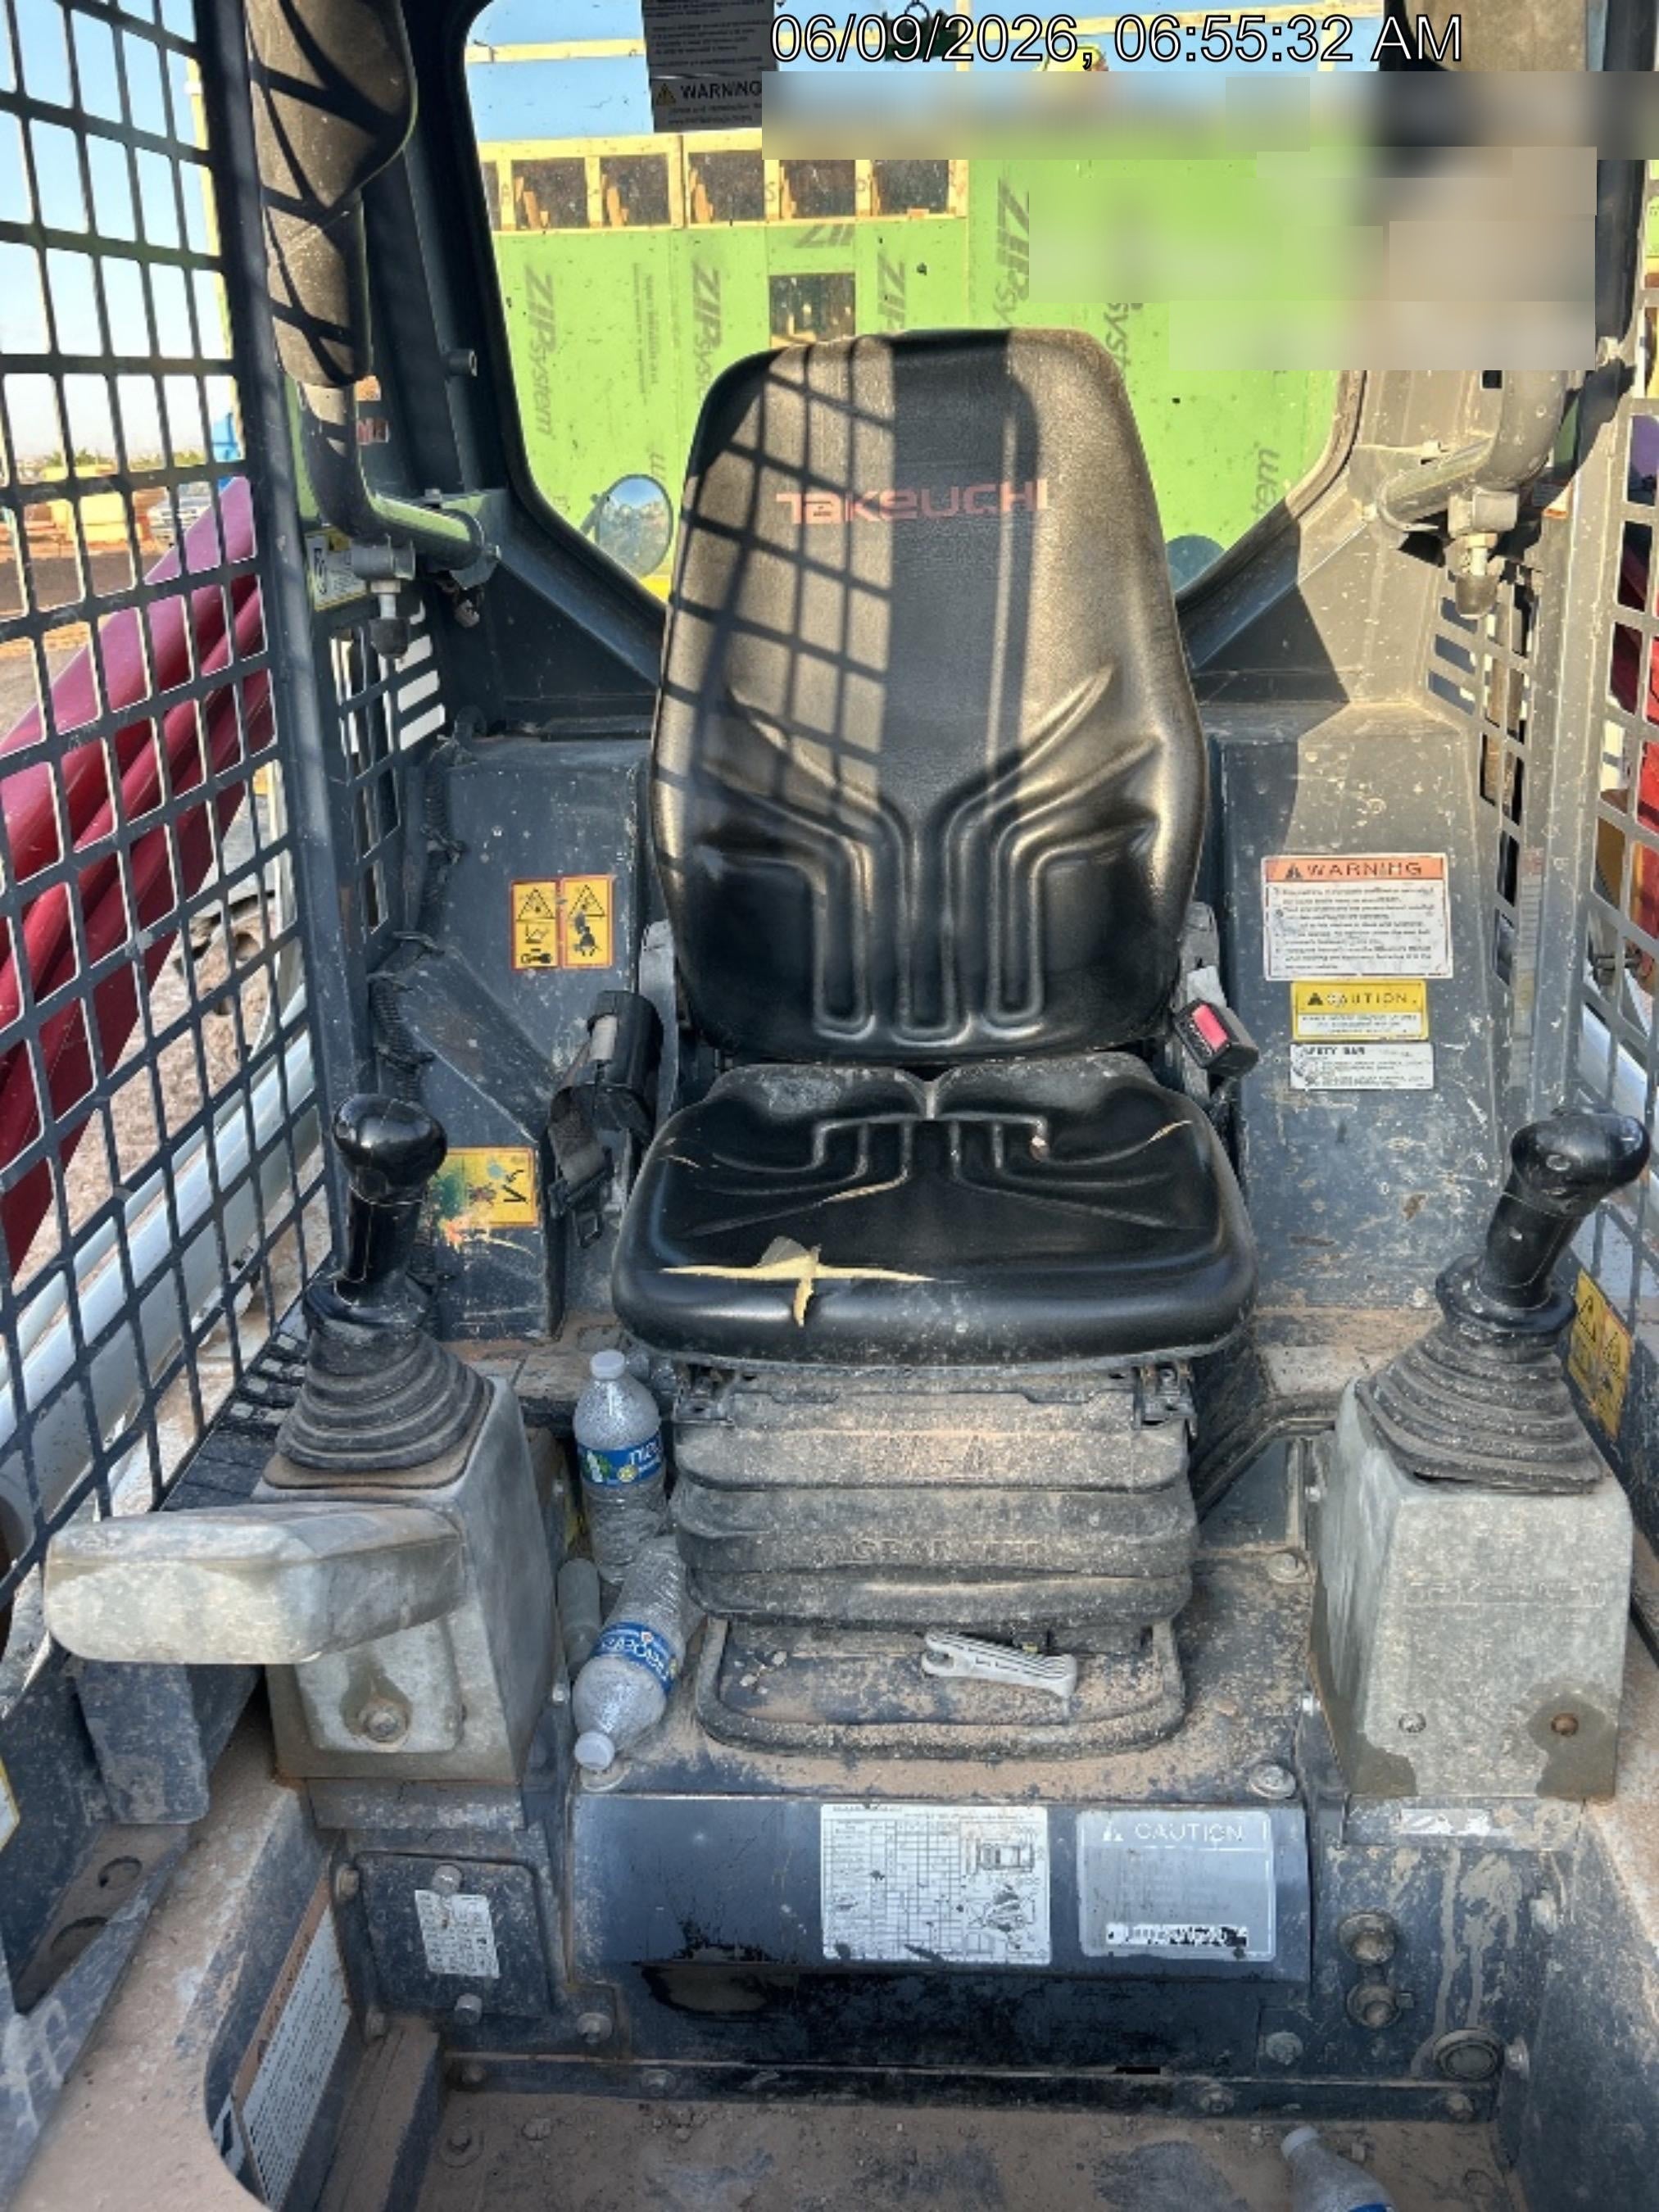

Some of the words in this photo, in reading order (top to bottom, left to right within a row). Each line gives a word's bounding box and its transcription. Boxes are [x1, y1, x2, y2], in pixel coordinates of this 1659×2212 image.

[776, 478, 1048, 524] TAKEUCHI
[1308, 862, 1422, 877] WARNING
[1326, 992, 1408, 1004] CAUTION
[1135, 1823, 1244, 1842] CAUTION
